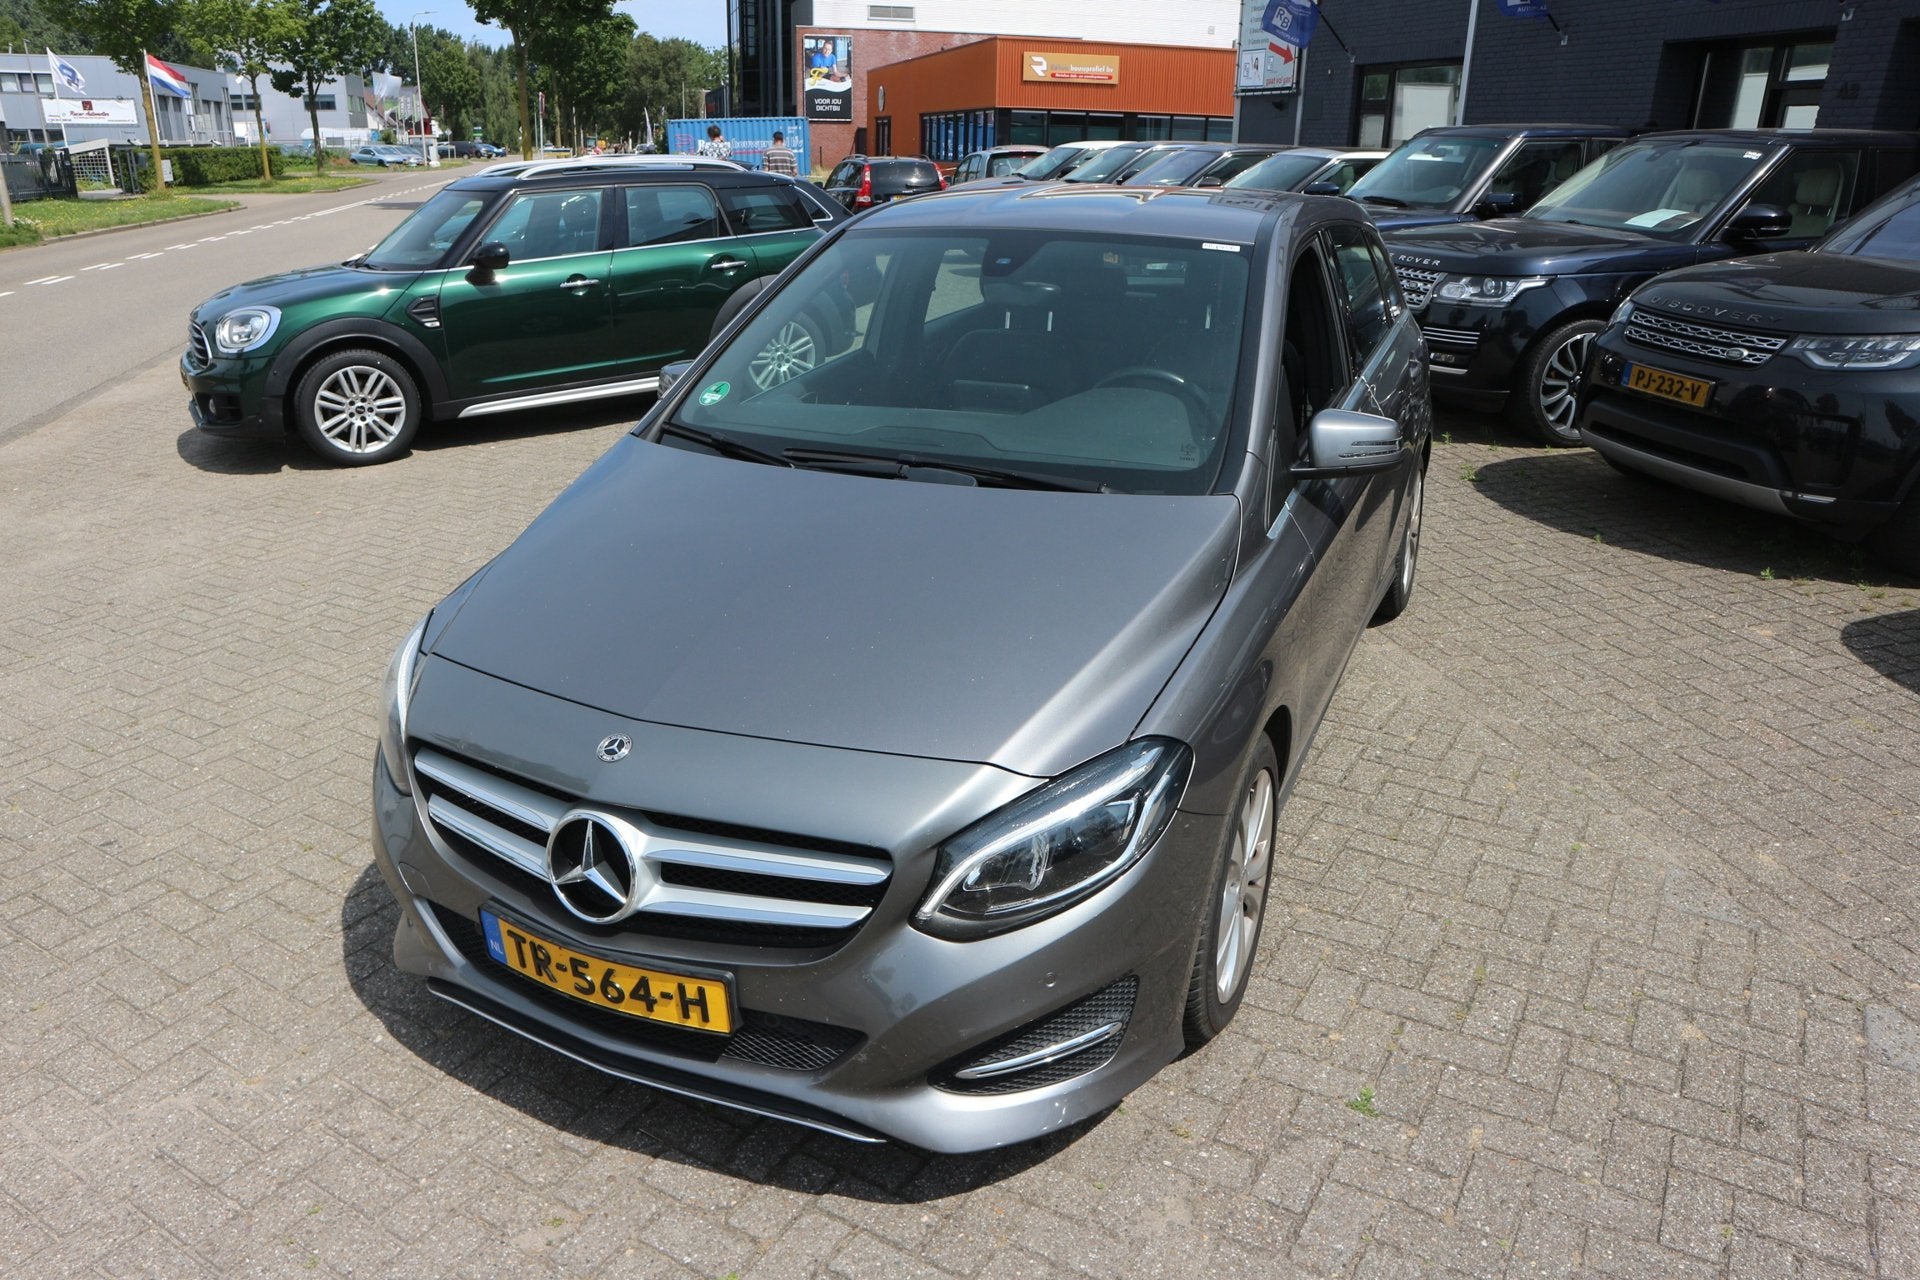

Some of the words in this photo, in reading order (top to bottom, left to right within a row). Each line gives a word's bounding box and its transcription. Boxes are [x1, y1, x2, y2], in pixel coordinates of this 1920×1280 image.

[1399, 254, 1441, 266] ROVER
[1651, 297, 1783, 323] DISCOVERY
[1635, 369, 1701, 402] PJ-232-V
[490, 940, 504, 954] NL
[507, 929, 710, 1023] TR-564-H
